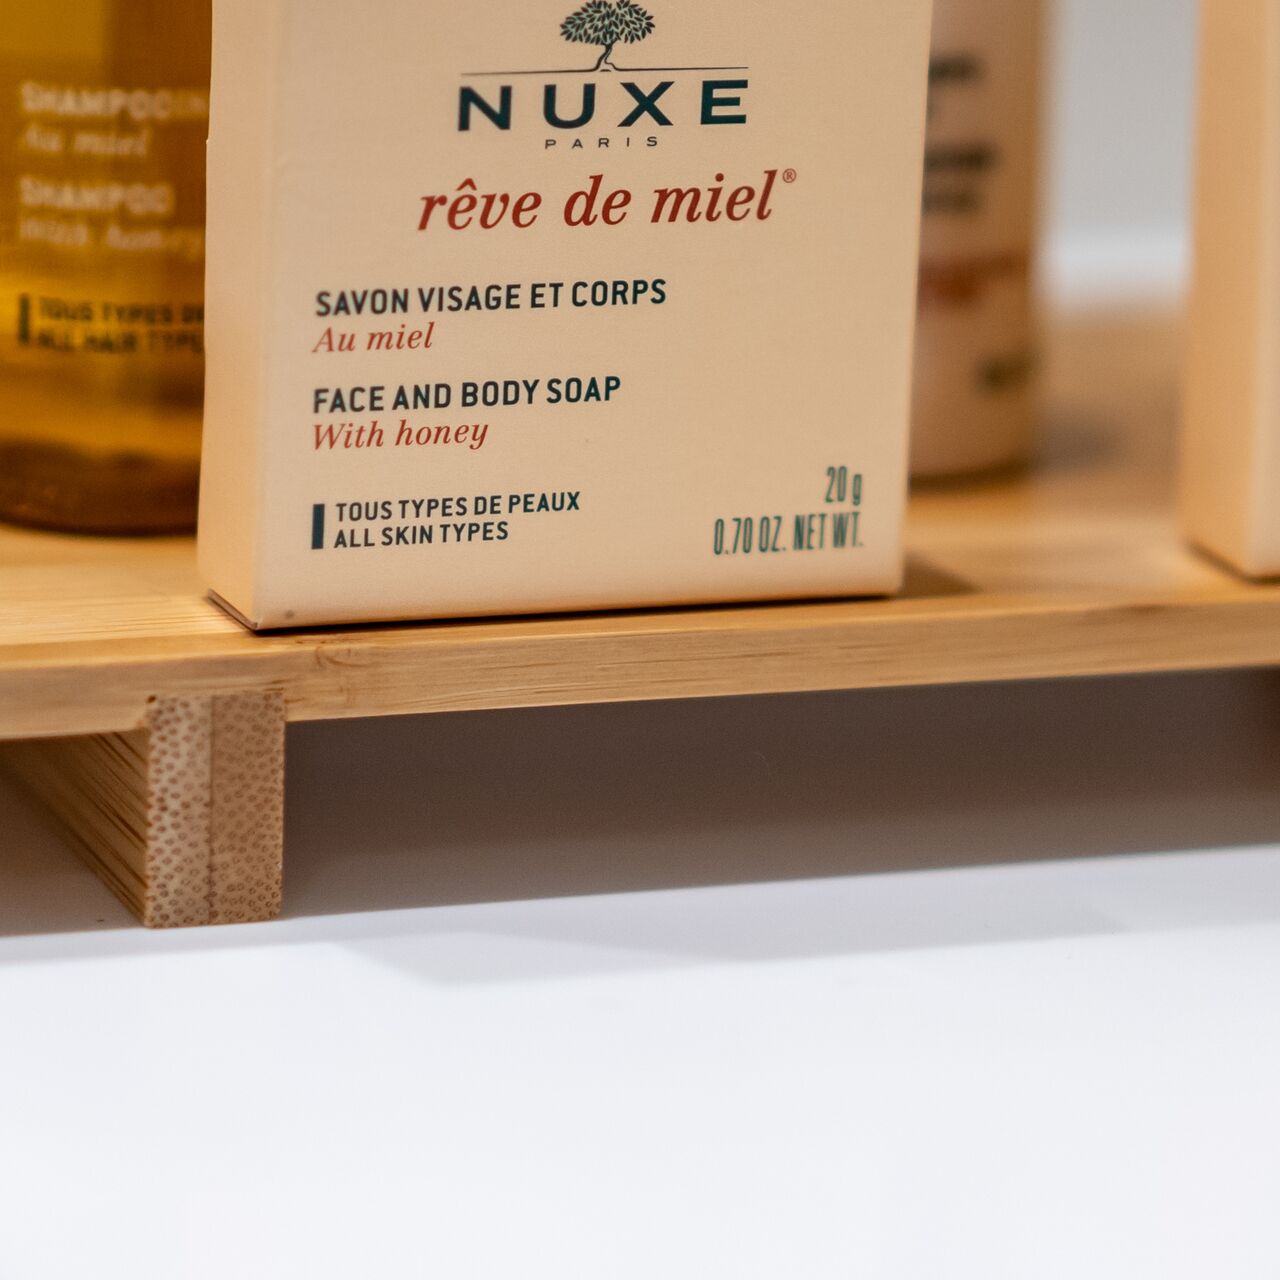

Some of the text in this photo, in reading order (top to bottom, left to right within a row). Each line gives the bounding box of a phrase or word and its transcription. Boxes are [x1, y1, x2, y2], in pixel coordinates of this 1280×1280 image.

[456, 78, 749, 132] NUXE
[544, 136, 659, 150] PARIS
[417, 177, 539, 232] rêve
[563, 175, 632, 228] de
[315, 278, 668, 318] SAVON VISAGE ET CORPS
[312, 321, 435, 355] Au miel
[313, 375, 622, 415] FACE AND BODY SOAP
[312, 417, 490, 452] With honey
[824, 465, 863, 506] 20 g
[335, 491, 581, 522] TOUS TYPES DE PEAUX
[333, 520, 509, 549] ALL SKIN TYPES
[713, 516, 754, 556] 0.70
[757, 515, 788, 553] OZ.
[793, 512, 828, 551] NET
